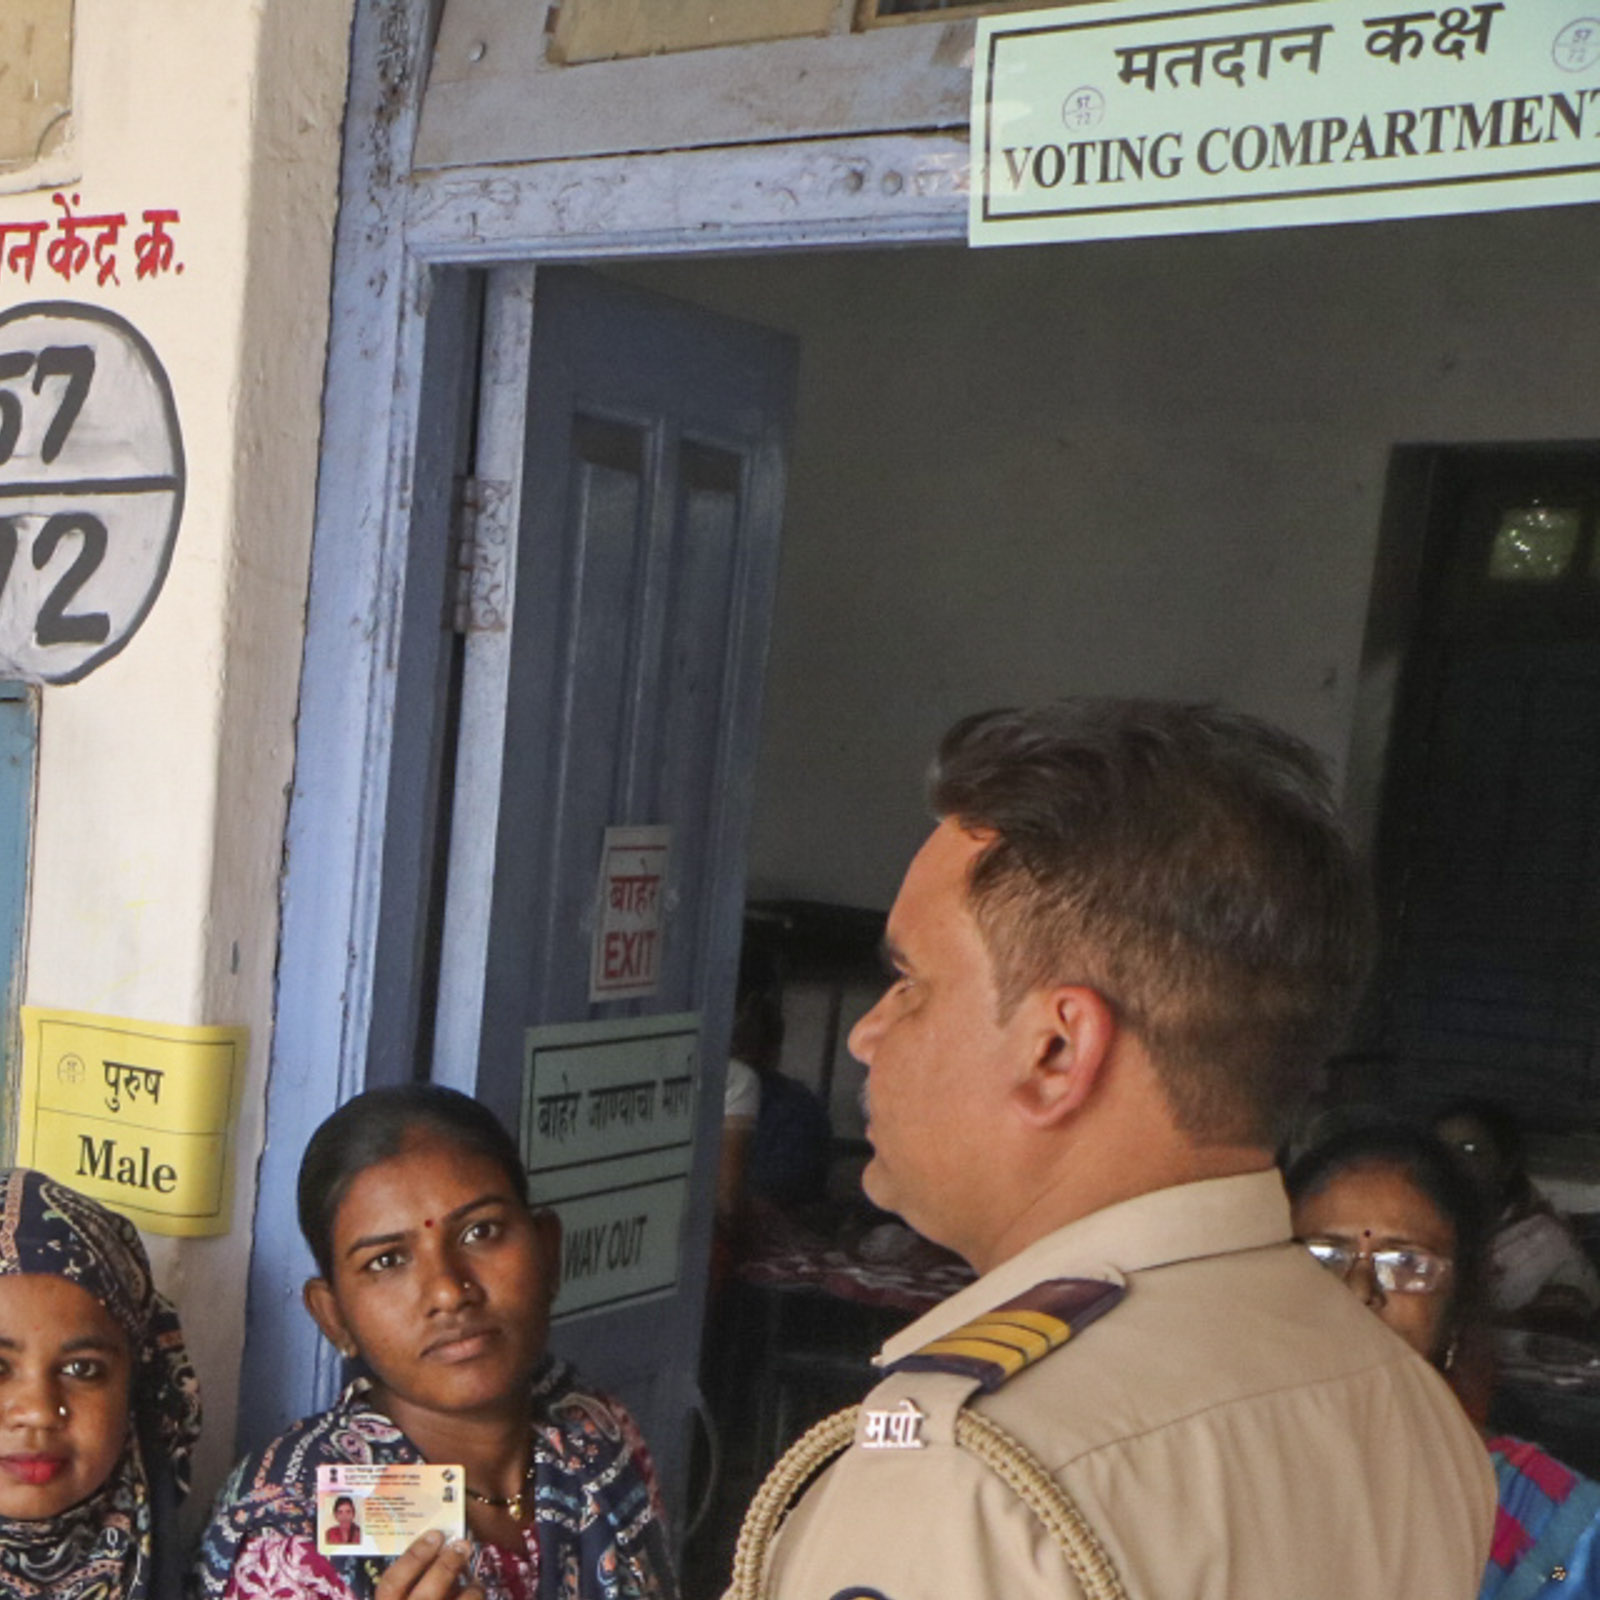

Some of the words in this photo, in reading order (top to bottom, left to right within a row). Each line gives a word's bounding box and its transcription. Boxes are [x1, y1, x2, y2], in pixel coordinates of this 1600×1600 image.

[1114, 24, 1334, 92] मतदान
[1363, 2, 1505, 65] कक्ष
[1002, 133, 1183, 190] VOTING
[46, 192, 127, 287] केंद्र
[135, 209, 184, 280] क्र.
[609, 857, 661, 918] बाहेर
[604, 930, 658, 981] EXIT
[102, 1060, 165, 1113] पुरुष
[537, 1071, 582, 1144] बाहेर
[75, 1134, 179, 1194] Male
[564, 1223, 607, 1283] WAY
[607, 1215, 648, 1272] OUT
